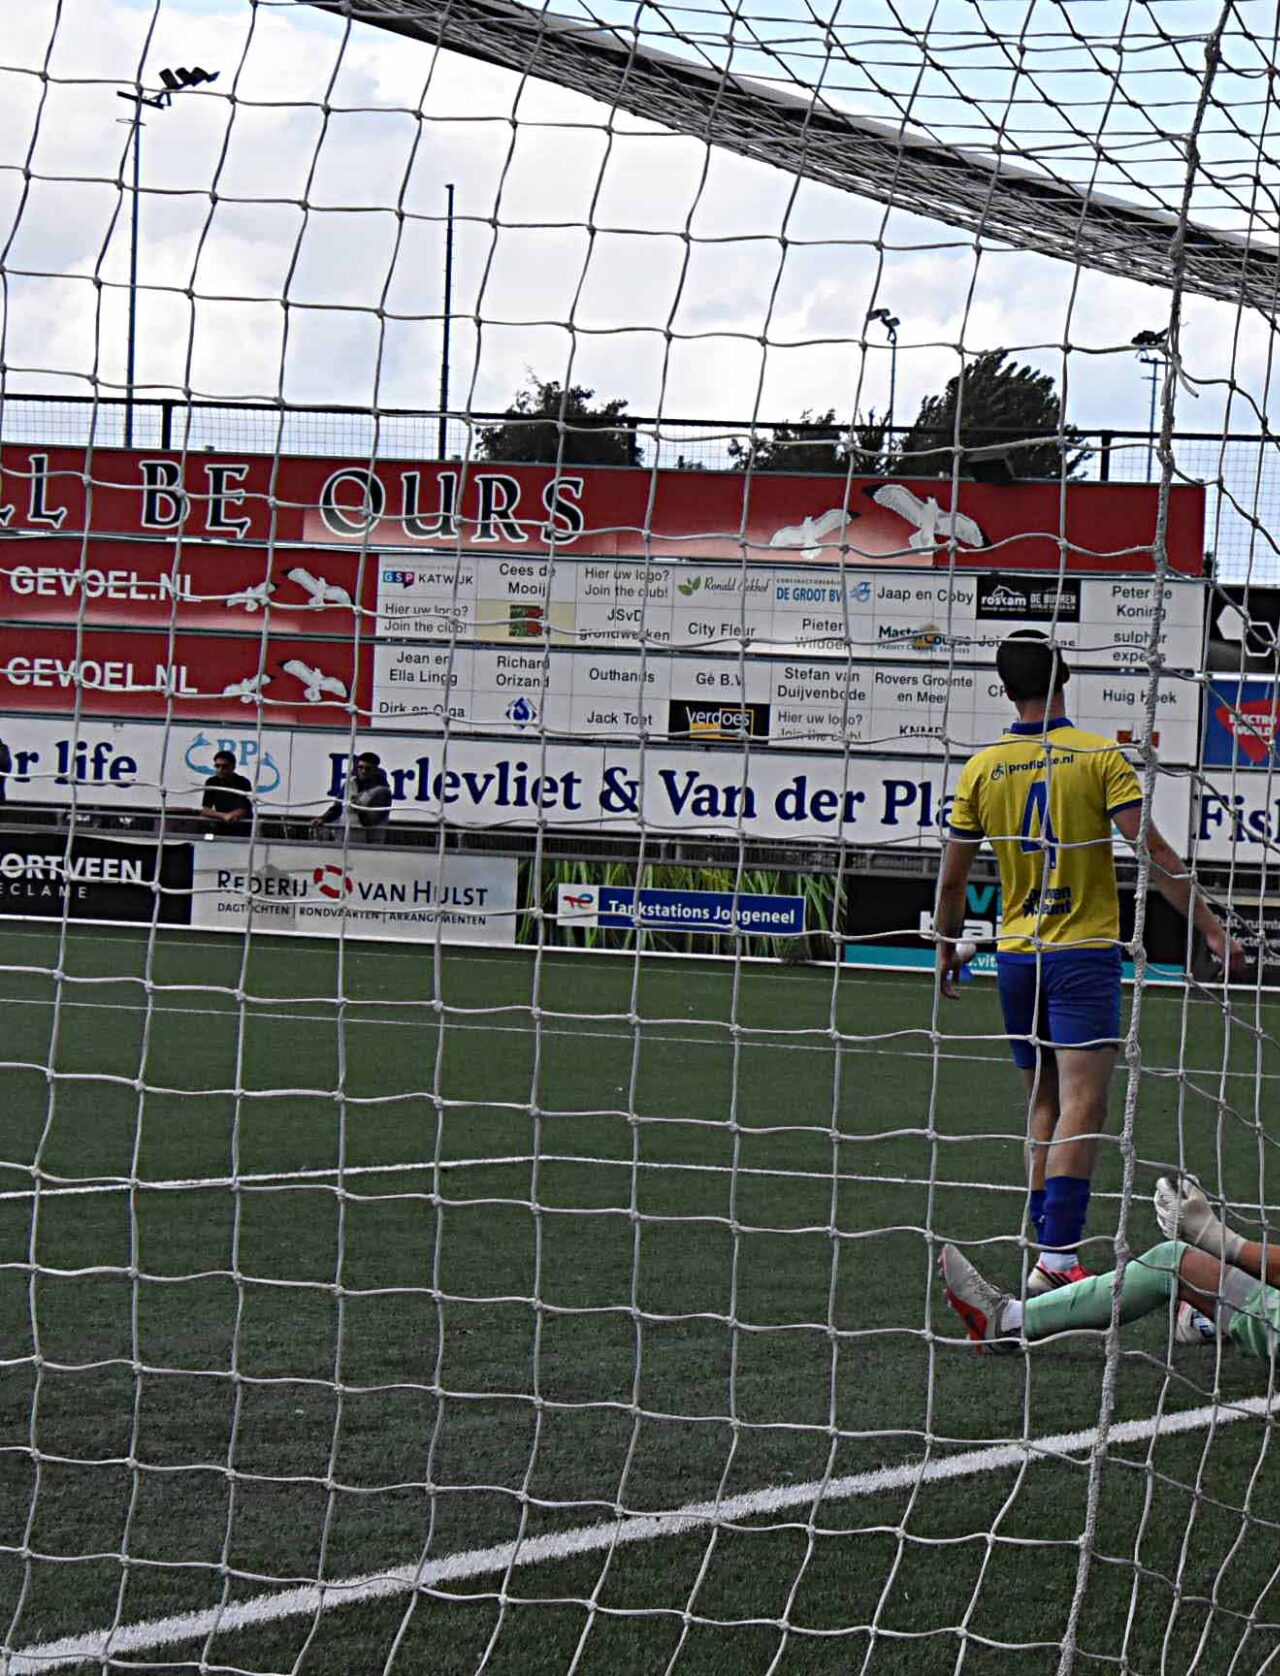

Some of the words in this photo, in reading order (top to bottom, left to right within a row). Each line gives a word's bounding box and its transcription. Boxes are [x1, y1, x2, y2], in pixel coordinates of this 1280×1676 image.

[138, 459, 252, 540] BE
[319, 466, 587, 544] OURS
[499, 563, 534, 577] Cees
[585, 567, 609, 580] Hier
[614, 571, 632, 580] uw
[9, 566, 202, 604] GEVOEL.NL
[418, 573, 474, 585] KATWJK
[507, 582, 547, 598] Mooij
[584, 584, 611, 597] Join
[615, 586, 635, 598] the
[776, 587, 790, 600] DE
[792, 587, 826, 601] GROOT
[877, 586, 912, 602] Jaap
[916, 590, 932, 601] en
[1112, 585, 1151, 599] Peter
[1154, 586, 1173, 600] e
[980, 593, 1027, 606] roskam
[384, 602, 410, 615] Hier
[413, 605, 432, 615] uw
[384, 619, 410, 632] Join
[414, 621, 434, 633] the
[688, 622, 716, 638] City
[802, 618, 844, 632] Pieter
[397, 652, 430, 665] Jean
[389, 669, 415, 682] Ella
[784, 667, 830, 681] Stefan
[875, 672, 919, 686] Rovers
[897, 692, 915, 703] en
[1103, 689, 1135, 705] Huig
[433, 705, 465, 719] Oga
[587, 711, 618, 724] Jack
[778, 711, 803, 724] Hier
[807, 714, 825, 724] uw
[829, 713, 863, 726] loo?
[54, 740, 139, 788] life
[326, 753, 583, 811] Prlevliet
[599, 766, 641, 813] &
[657, 769, 758, 819] Van
[774, 775, 866, 824] der
[1019, 779, 1060, 870] 4
[217, 869, 308, 897] REDERIJ
[358, 881, 406, 903] VAN
[217, 902, 290, 916] DAGTCHTEN
[608, 899, 711, 921] Tankstations
